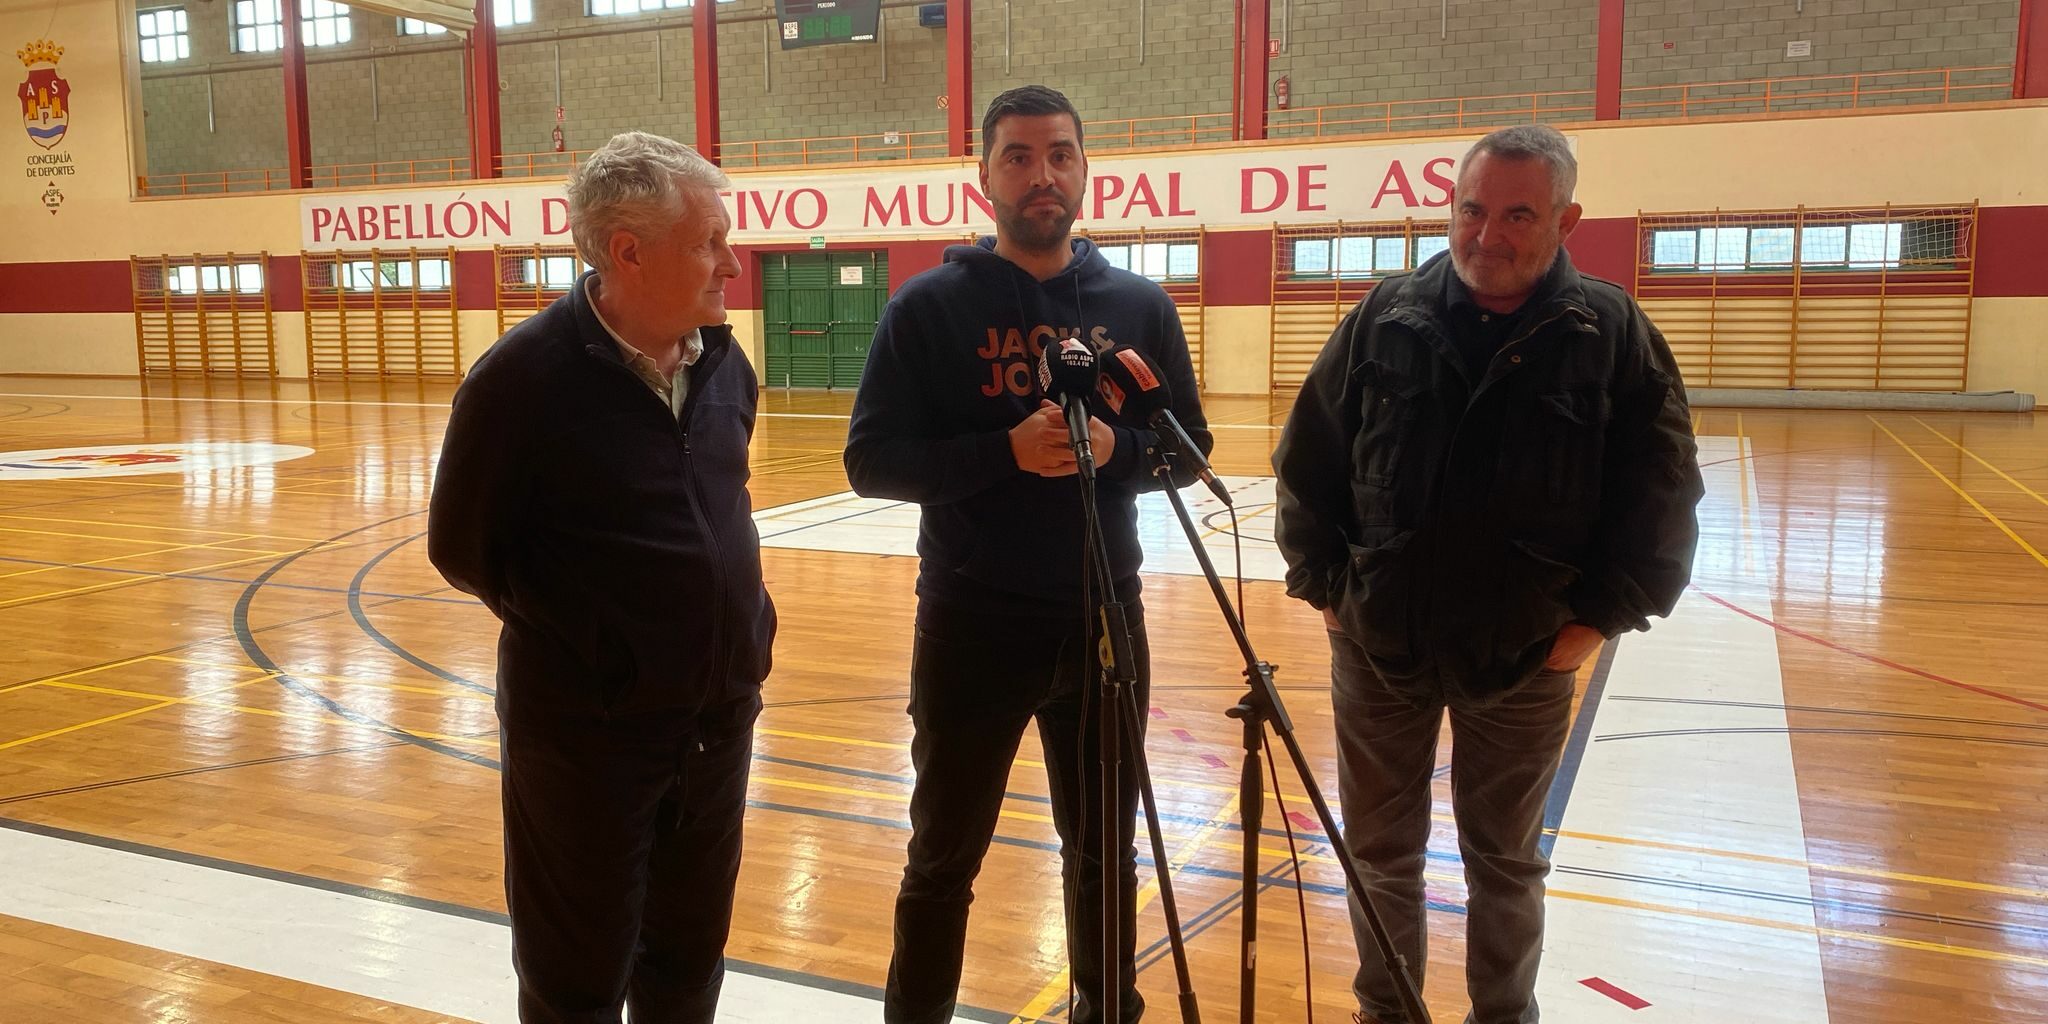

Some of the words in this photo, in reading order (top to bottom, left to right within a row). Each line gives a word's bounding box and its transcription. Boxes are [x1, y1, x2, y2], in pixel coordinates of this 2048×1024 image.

[27, 150, 72, 165] CONCEJALÍA
[26, 167, 37, 177] DE
[38, 165, 75, 177] DEPORTES
[45, 189, 61, 197] ASPE
[312, 192, 511, 242] PABELLÓN
[863, 172, 1196, 228] MUNPAL
[1240, 164, 1328, 214] DE
[1370, 157, 1457, 209] AS
